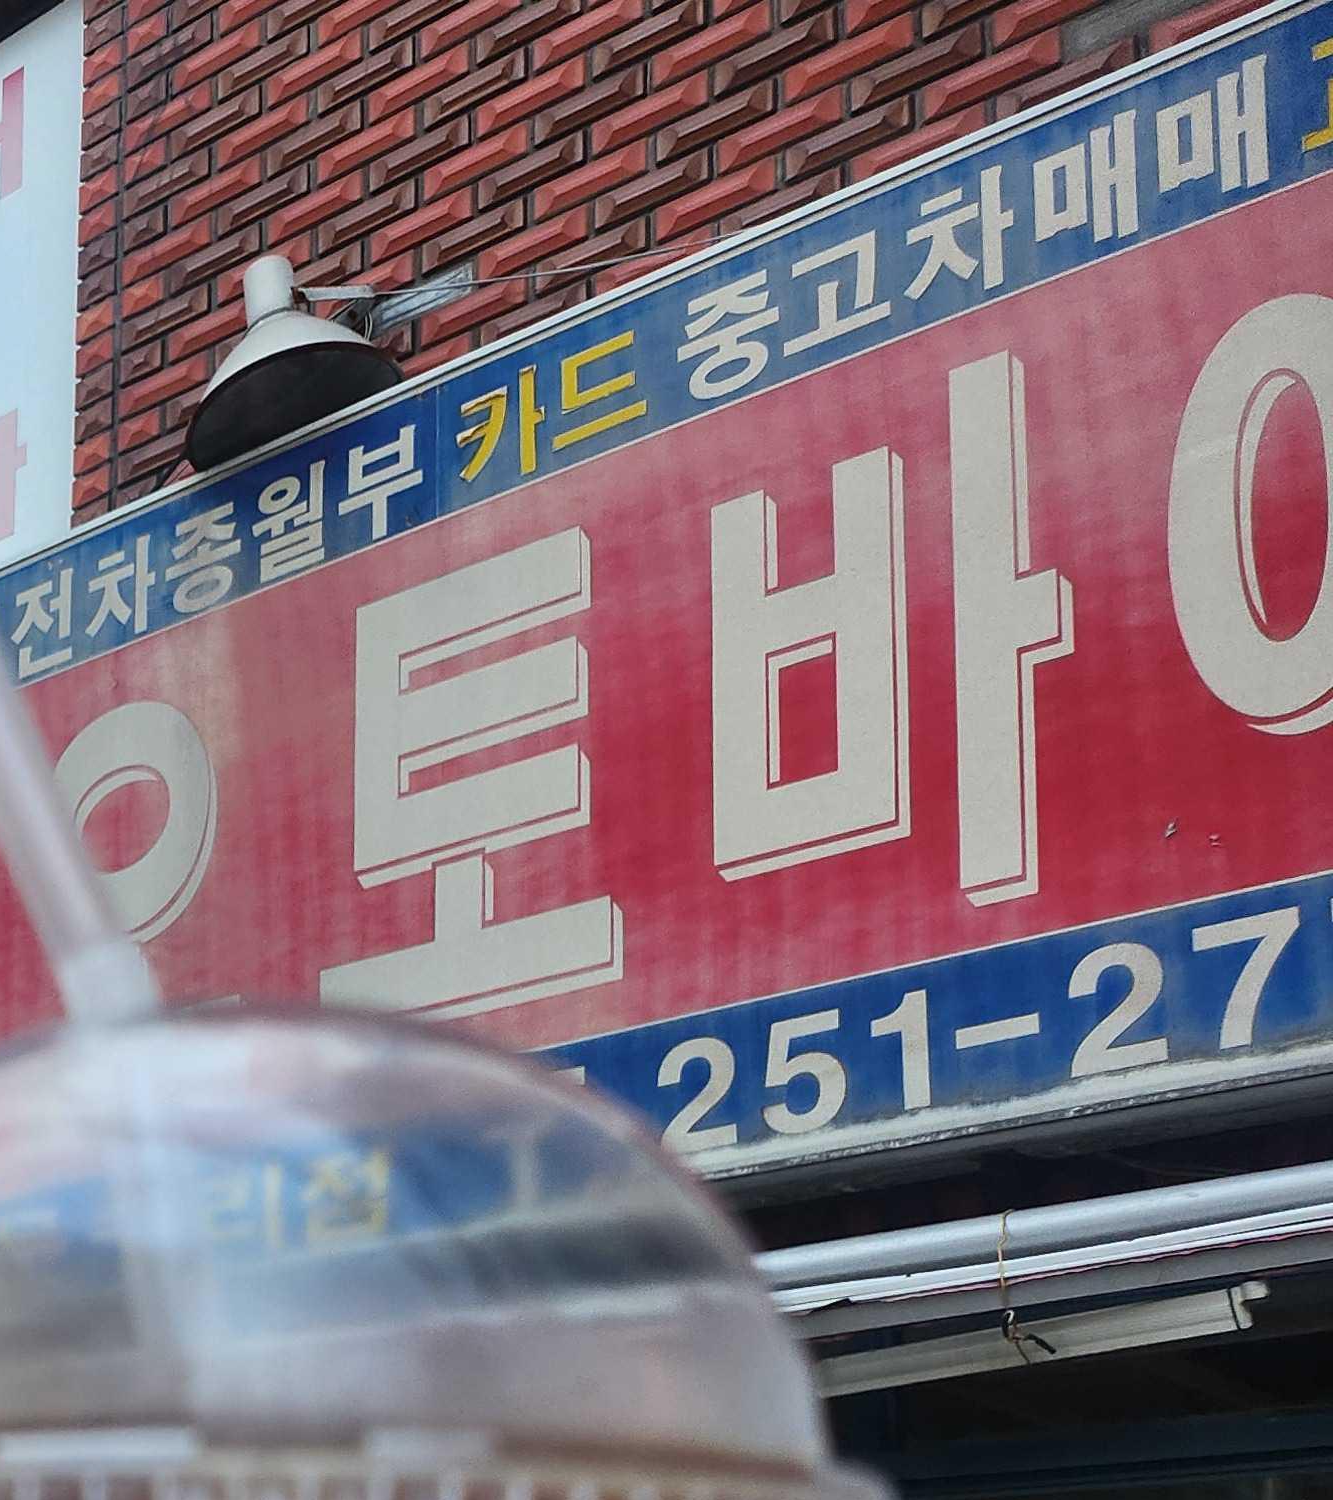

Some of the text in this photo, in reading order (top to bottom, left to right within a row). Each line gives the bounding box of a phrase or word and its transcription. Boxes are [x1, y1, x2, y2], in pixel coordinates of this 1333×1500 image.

[457, 331, 646, 482] 카드
[676, 53, 1273, 401] 중고차매매
[656, 893, 1333, 1153] 251-27
